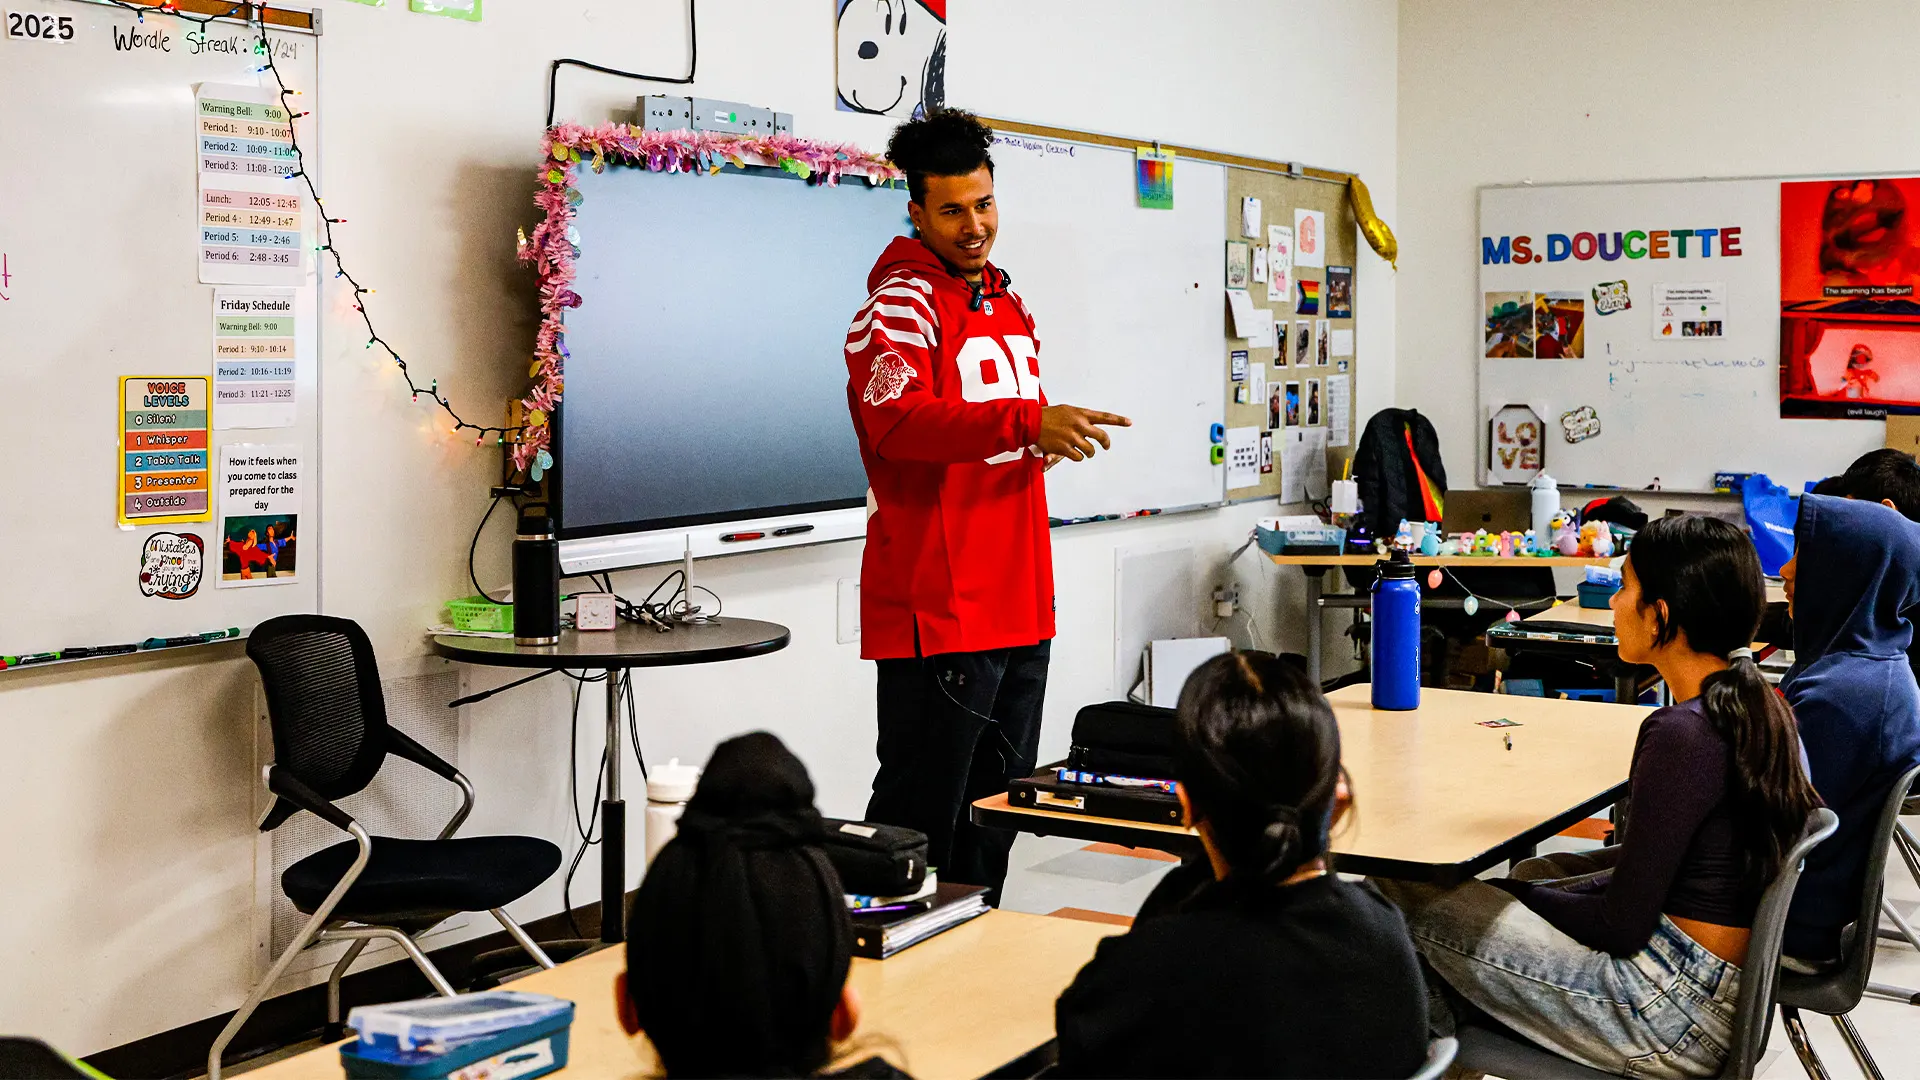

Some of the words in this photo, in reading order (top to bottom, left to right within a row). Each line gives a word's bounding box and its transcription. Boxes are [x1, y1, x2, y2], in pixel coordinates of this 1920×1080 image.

[9, 13, 74, 40] 2025
[113, 25, 171, 52] Wordle
[202, 102, 235, 116] Warning
[236, 106, 253, 116] Bell:
[265, 109, 282, 119] 9:00
[203, 121, 229, 133] Period
[231, 124, 238, 133] 1:
[247, 126, 264, 136] 9:10
[271, 128, 291, 138] 10:07
[204, 141, 229, 152] Period
[231, 143, 238, 152] 2:
[247, 144, 268, 154] 10:09
[205, 160, 229, 171] Period
[231, 162, 238, 171] 3:
[247, 163, 267, 173] 11:08
[274, 165, 294, 175] 12:05
[206, 193, 232, 204] Lunch:
[249, 196, 271, 207] 12:05
[277, 198, 297, 209] 12:45
[205, 212, 230, 223] Period
[249, 215, 271, 225] 12:49
[277, 217, 294, 227] 1:47
[204, 231, 230, 241] Period
[232, 232, 239, 242] 5:
[251, 234, 268, 244] 1:49
[273, 235, 291, 245] 2:46
[1482, 235, 1542, 265] MS.
[1547, 226, 1742, 262] DOUCETTE
[205, 250, 230, 261] Period
[232, 251, 239, 261] 6:
[249, 252, 267, 262] 2:48
[273, 253, 289, 263] 3:45
[1824, 287, 1839, 295] The
[1840, 287, 1870, 295] learning
[1886, 287, 1912, 295] begun!
[220, 300, 251, 312] Friday
[252, 300, 291, 311] Schedule
[219, 322, 247, 332] Warning
[248, 322, 262, 330] Bell:
[264, 322, 278, 331] 9:00
[218, 345, 239, 353] Period
[240, 345, 247, 353] 1:
[250, 345, 265, 353] 9:10
[269, 345, 287, 353] 10:14
[218, 368, 239, 376] Period
[240, 368, 247, 376] 2:
[251, 367, 269, 375] 10:16
[274, 367, 292, 375] 11:19
[146, 382, 186, 394] VOICE
[218, 390, 239, 399] Period
[239, 390, 246, 398] 3:
[251, 390, 269, 398] 11:21
[274, 389, 292, 398] 12:25
[144, 395, 190, 408] LEVELS
[135, 414, 143, 426] 0
[146, 413, 177, 424] Silent
[135, 435, 142, 446] 1
[146, 434, 189, 446] Whisper
[134, 456, 142, 467] 2
[146, 455, 175, 466] Table
[178, 454, 200, 464] Talk
[229, 457, 247, 466] How
[248, 456, 255, 466] it
[255, 456, 275, 466] feels
[276, 456, 297, 465] when
[134, 476, 142, 490] 3
[146, 475, 199, 487] Presenter
[227, 473, 243, 483] you
[267, 472, 276, 480] to
[277, 471, 297, 480] class
[229, 485, 266, 497] prepared
[267, 485, 279, 494] for
[281, 485, 294, 494] the
[134, 498, 142, 511] 4
[146, 495, 187, 508] Outside
[254, 500, 269, 511] day
